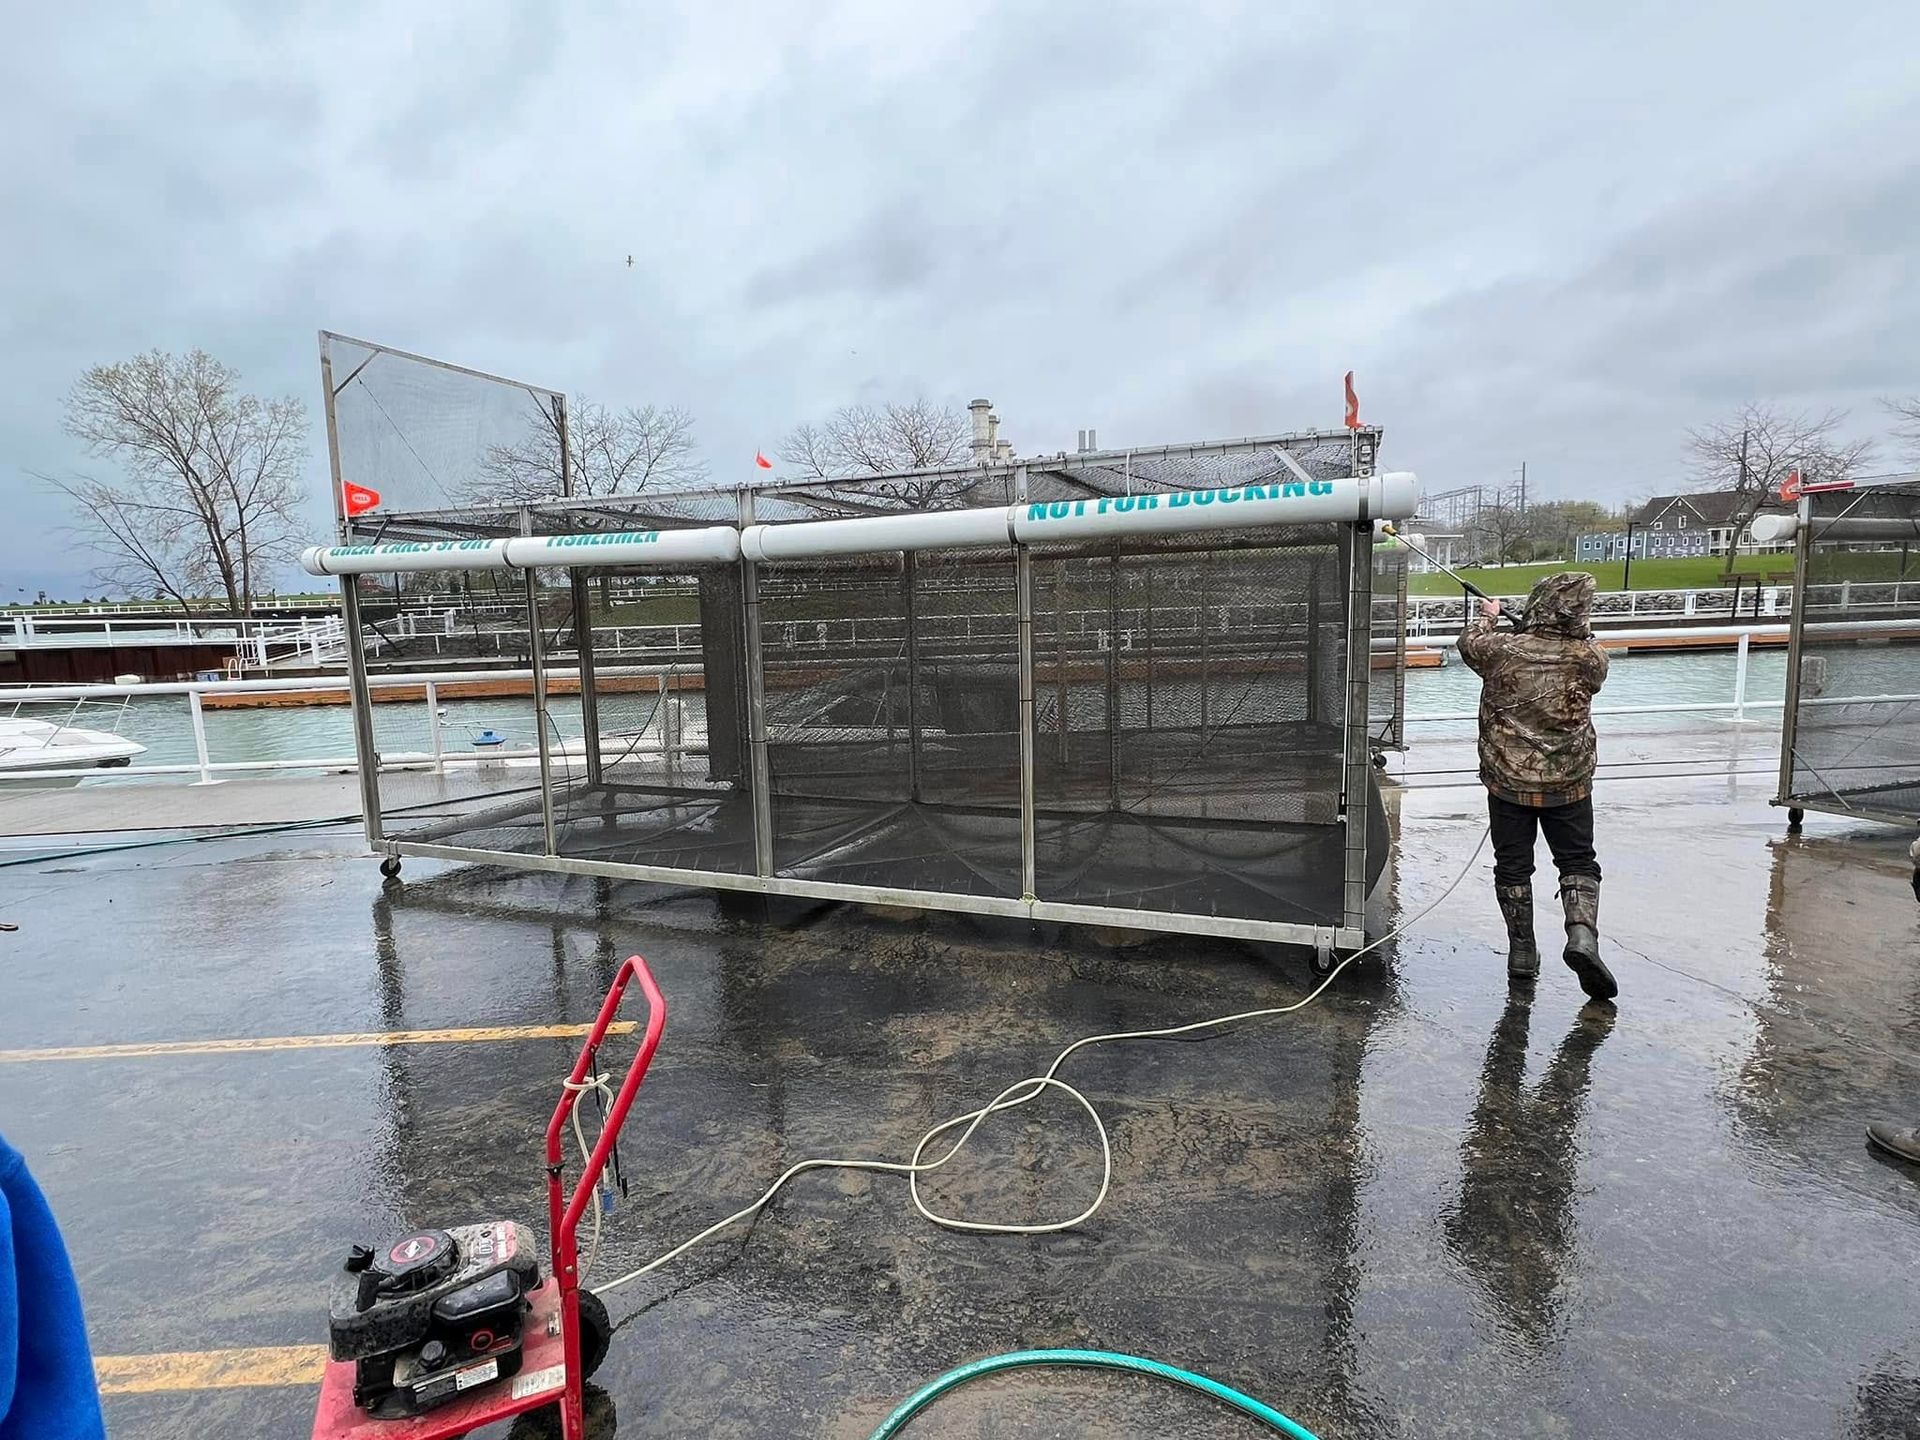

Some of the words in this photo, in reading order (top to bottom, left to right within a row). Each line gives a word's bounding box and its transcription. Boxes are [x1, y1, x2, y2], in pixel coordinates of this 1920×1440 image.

[1027, 501, 1086, 521] NOT
[1097, 494, 1158, 514] FOR
[1169, 481, 1333, 507] DOCKING
